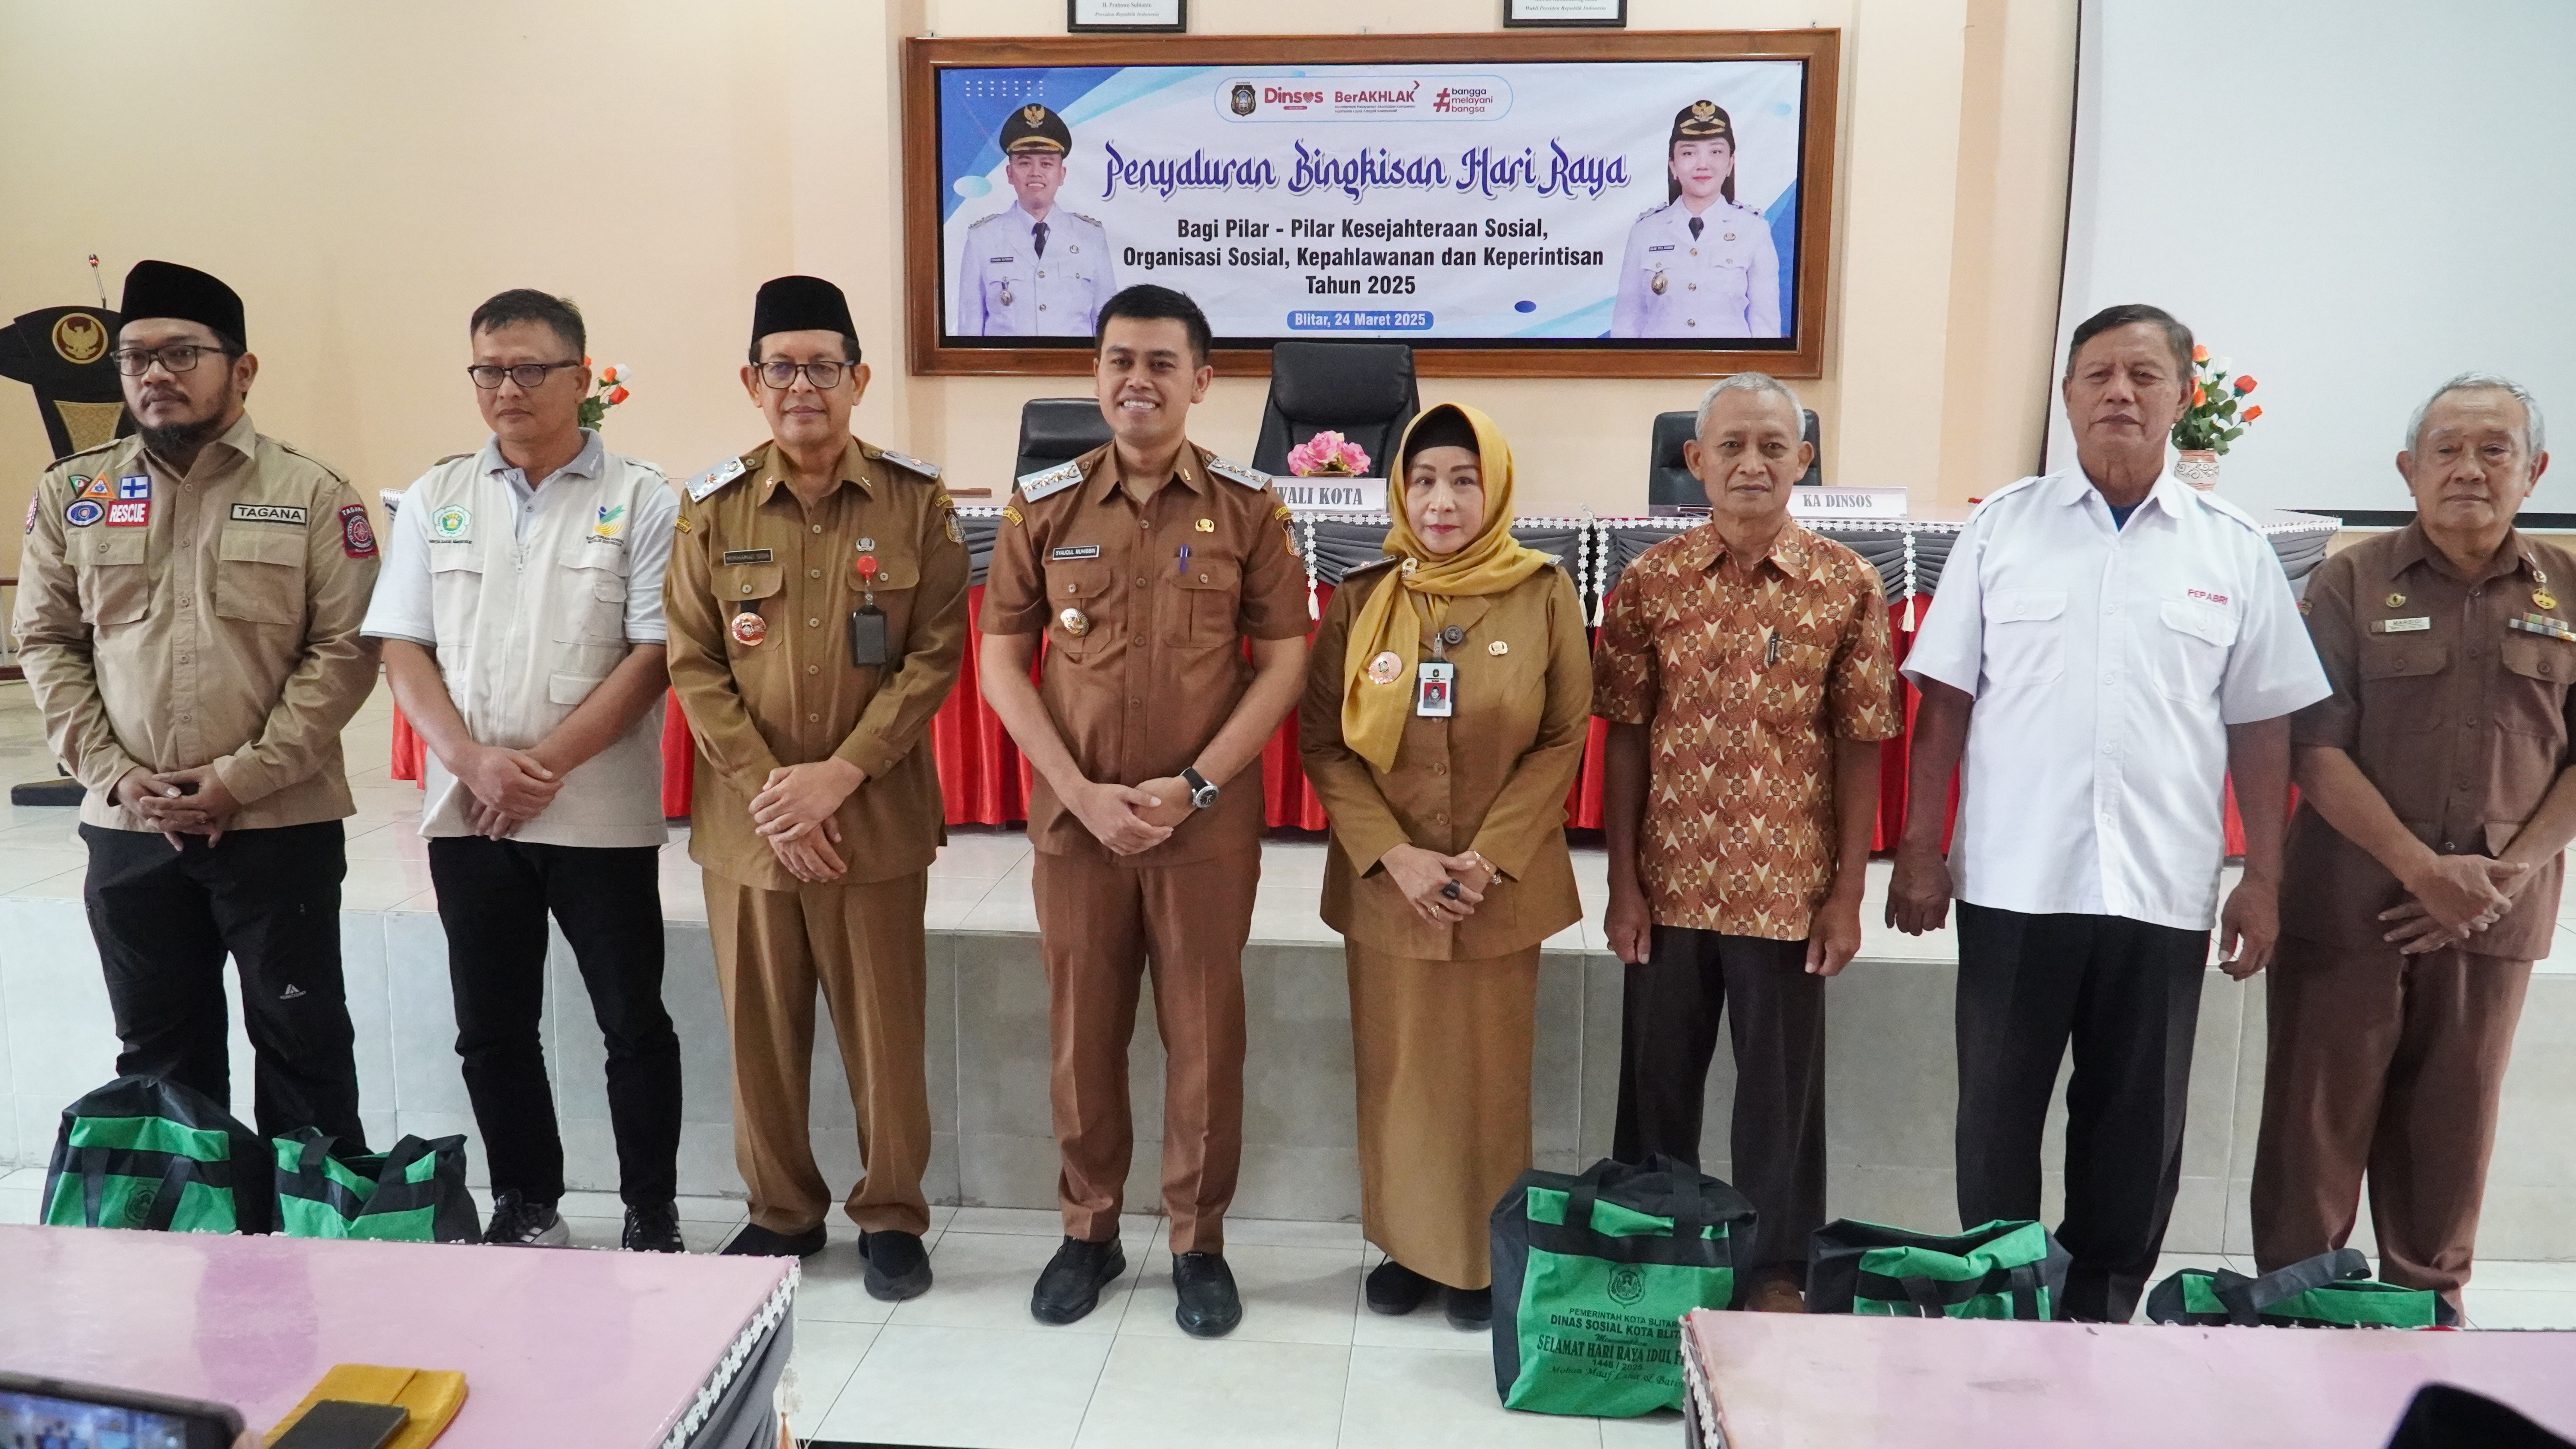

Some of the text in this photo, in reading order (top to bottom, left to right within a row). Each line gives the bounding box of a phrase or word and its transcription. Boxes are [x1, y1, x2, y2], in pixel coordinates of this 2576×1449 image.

[1335, 90, 1416, 103] BerAKHLAK
[1452, 88, 1486, 97] bangga
[1452, 96, 1493, 105] melayani
[1452, 105, 1485, 114] bangsa
[1101, 137, 1628, 202] Penyaluran Bingkisan Hari Raya
[1177, 218, 1218, 242] Bagi
[1226, 218, 1270, 238] Pilar
[1291, 218, 1335, 238] Pilar
[1342, 218, 1478, 242] Kesejahteraan
[1485, 218, 1548, 241] Sosial,
[1123, 246, 1604, 270] Organisasi Sosial, Kepahlawanan dan Keperintisan
[1306, 275, 1416, 294] Tahun 2025
[1295, 313, 1426, 327] Blitar, 24 Maret 2025
[1318, 487, 1363, 505] KOTA
[1803, 494, 1872, 508] KA DINSOS
[109, 503, 146, 523] RESCUE
[238, 507, 302, 520] TAGANA
[1550, 1313, 1583, 1328] DINAS
[1585, 1319, 1623, 1334] SOSIAL
[1625, 1324, 1653, 1337] KOTA
[1569, 1307, 1679, 1328] PEMERINTAH KOTA BLITAR
[1537, 1334, 1585, 1356] SELAMAT
[1587, 1342, 1614, 1359] HARI
[1616, 1345, 1644, 1362] RAYA
[1646, 1348, 1672, 1365] IDUL
[1621, 1363, 1643, 1371] 2025
